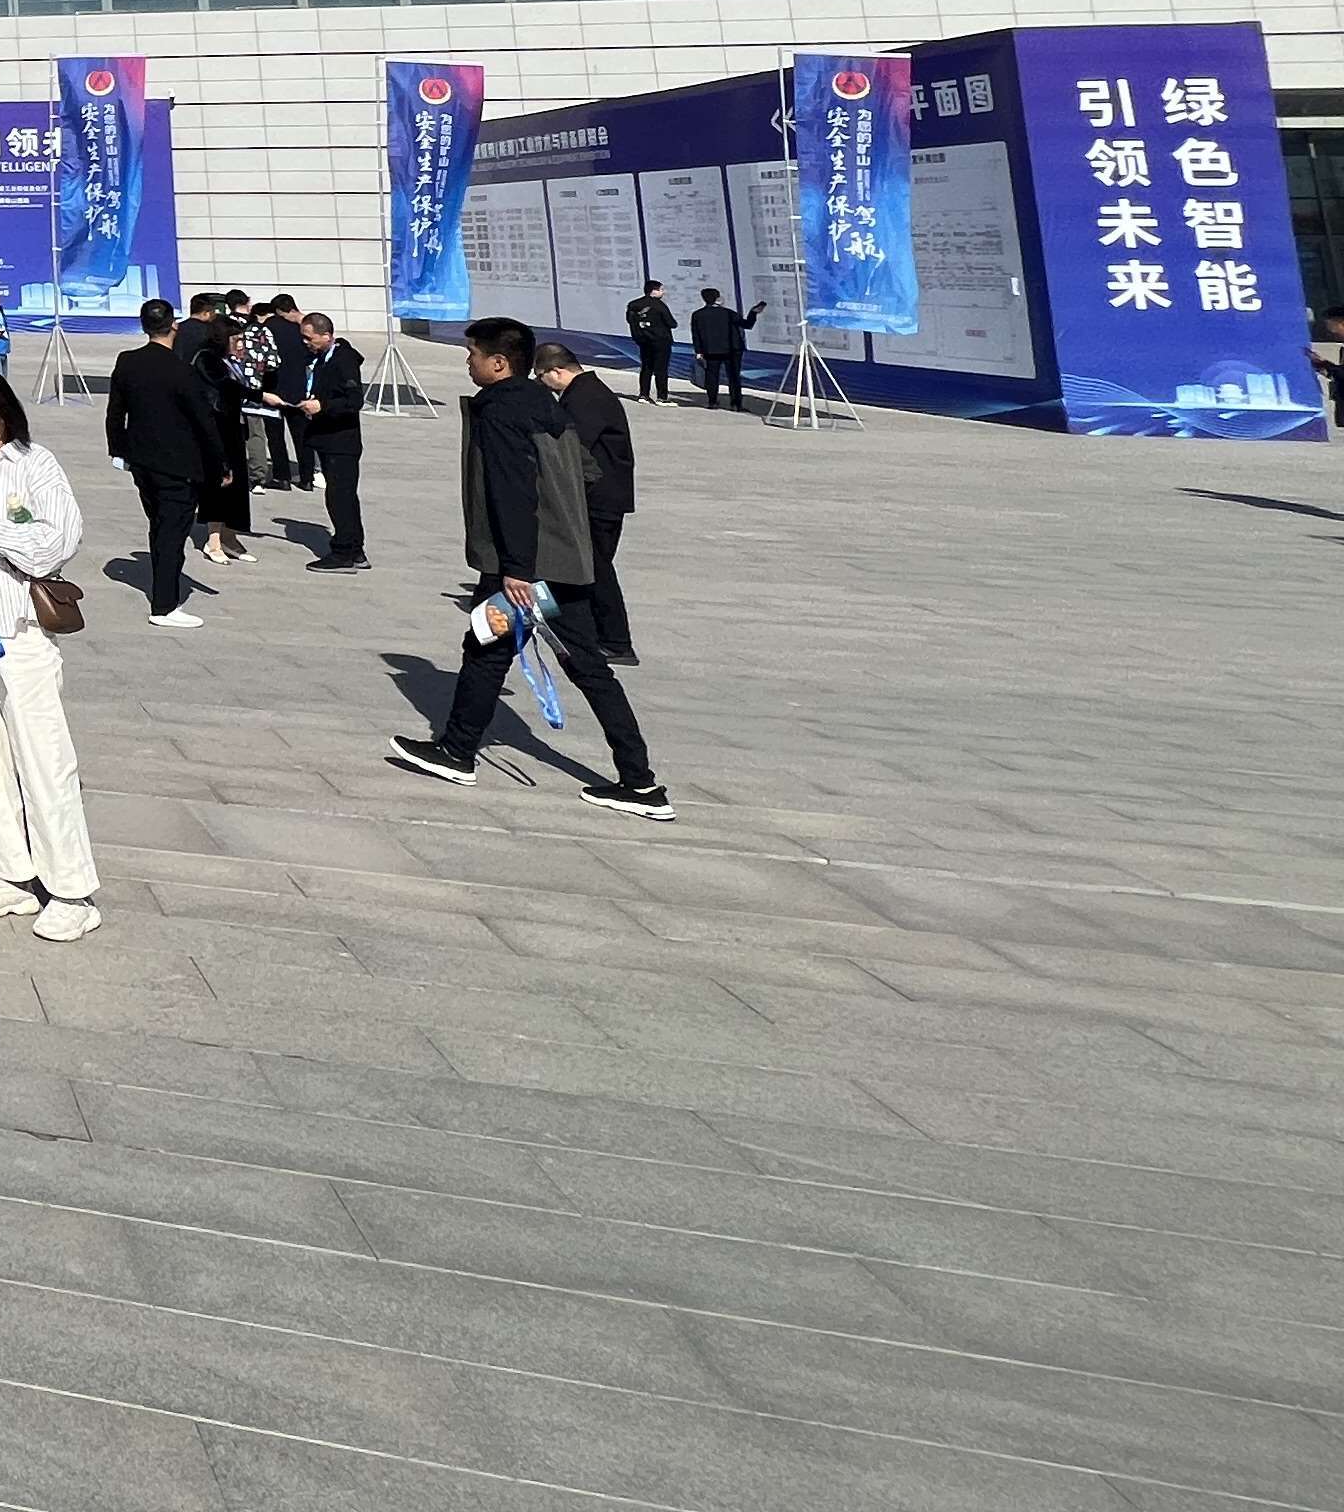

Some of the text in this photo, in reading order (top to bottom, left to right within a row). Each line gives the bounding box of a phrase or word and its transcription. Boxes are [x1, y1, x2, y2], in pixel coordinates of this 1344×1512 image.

[1076, 78, 1173, 312] 引领未来
[1161, 77, 1263, 312] 绿色智能
